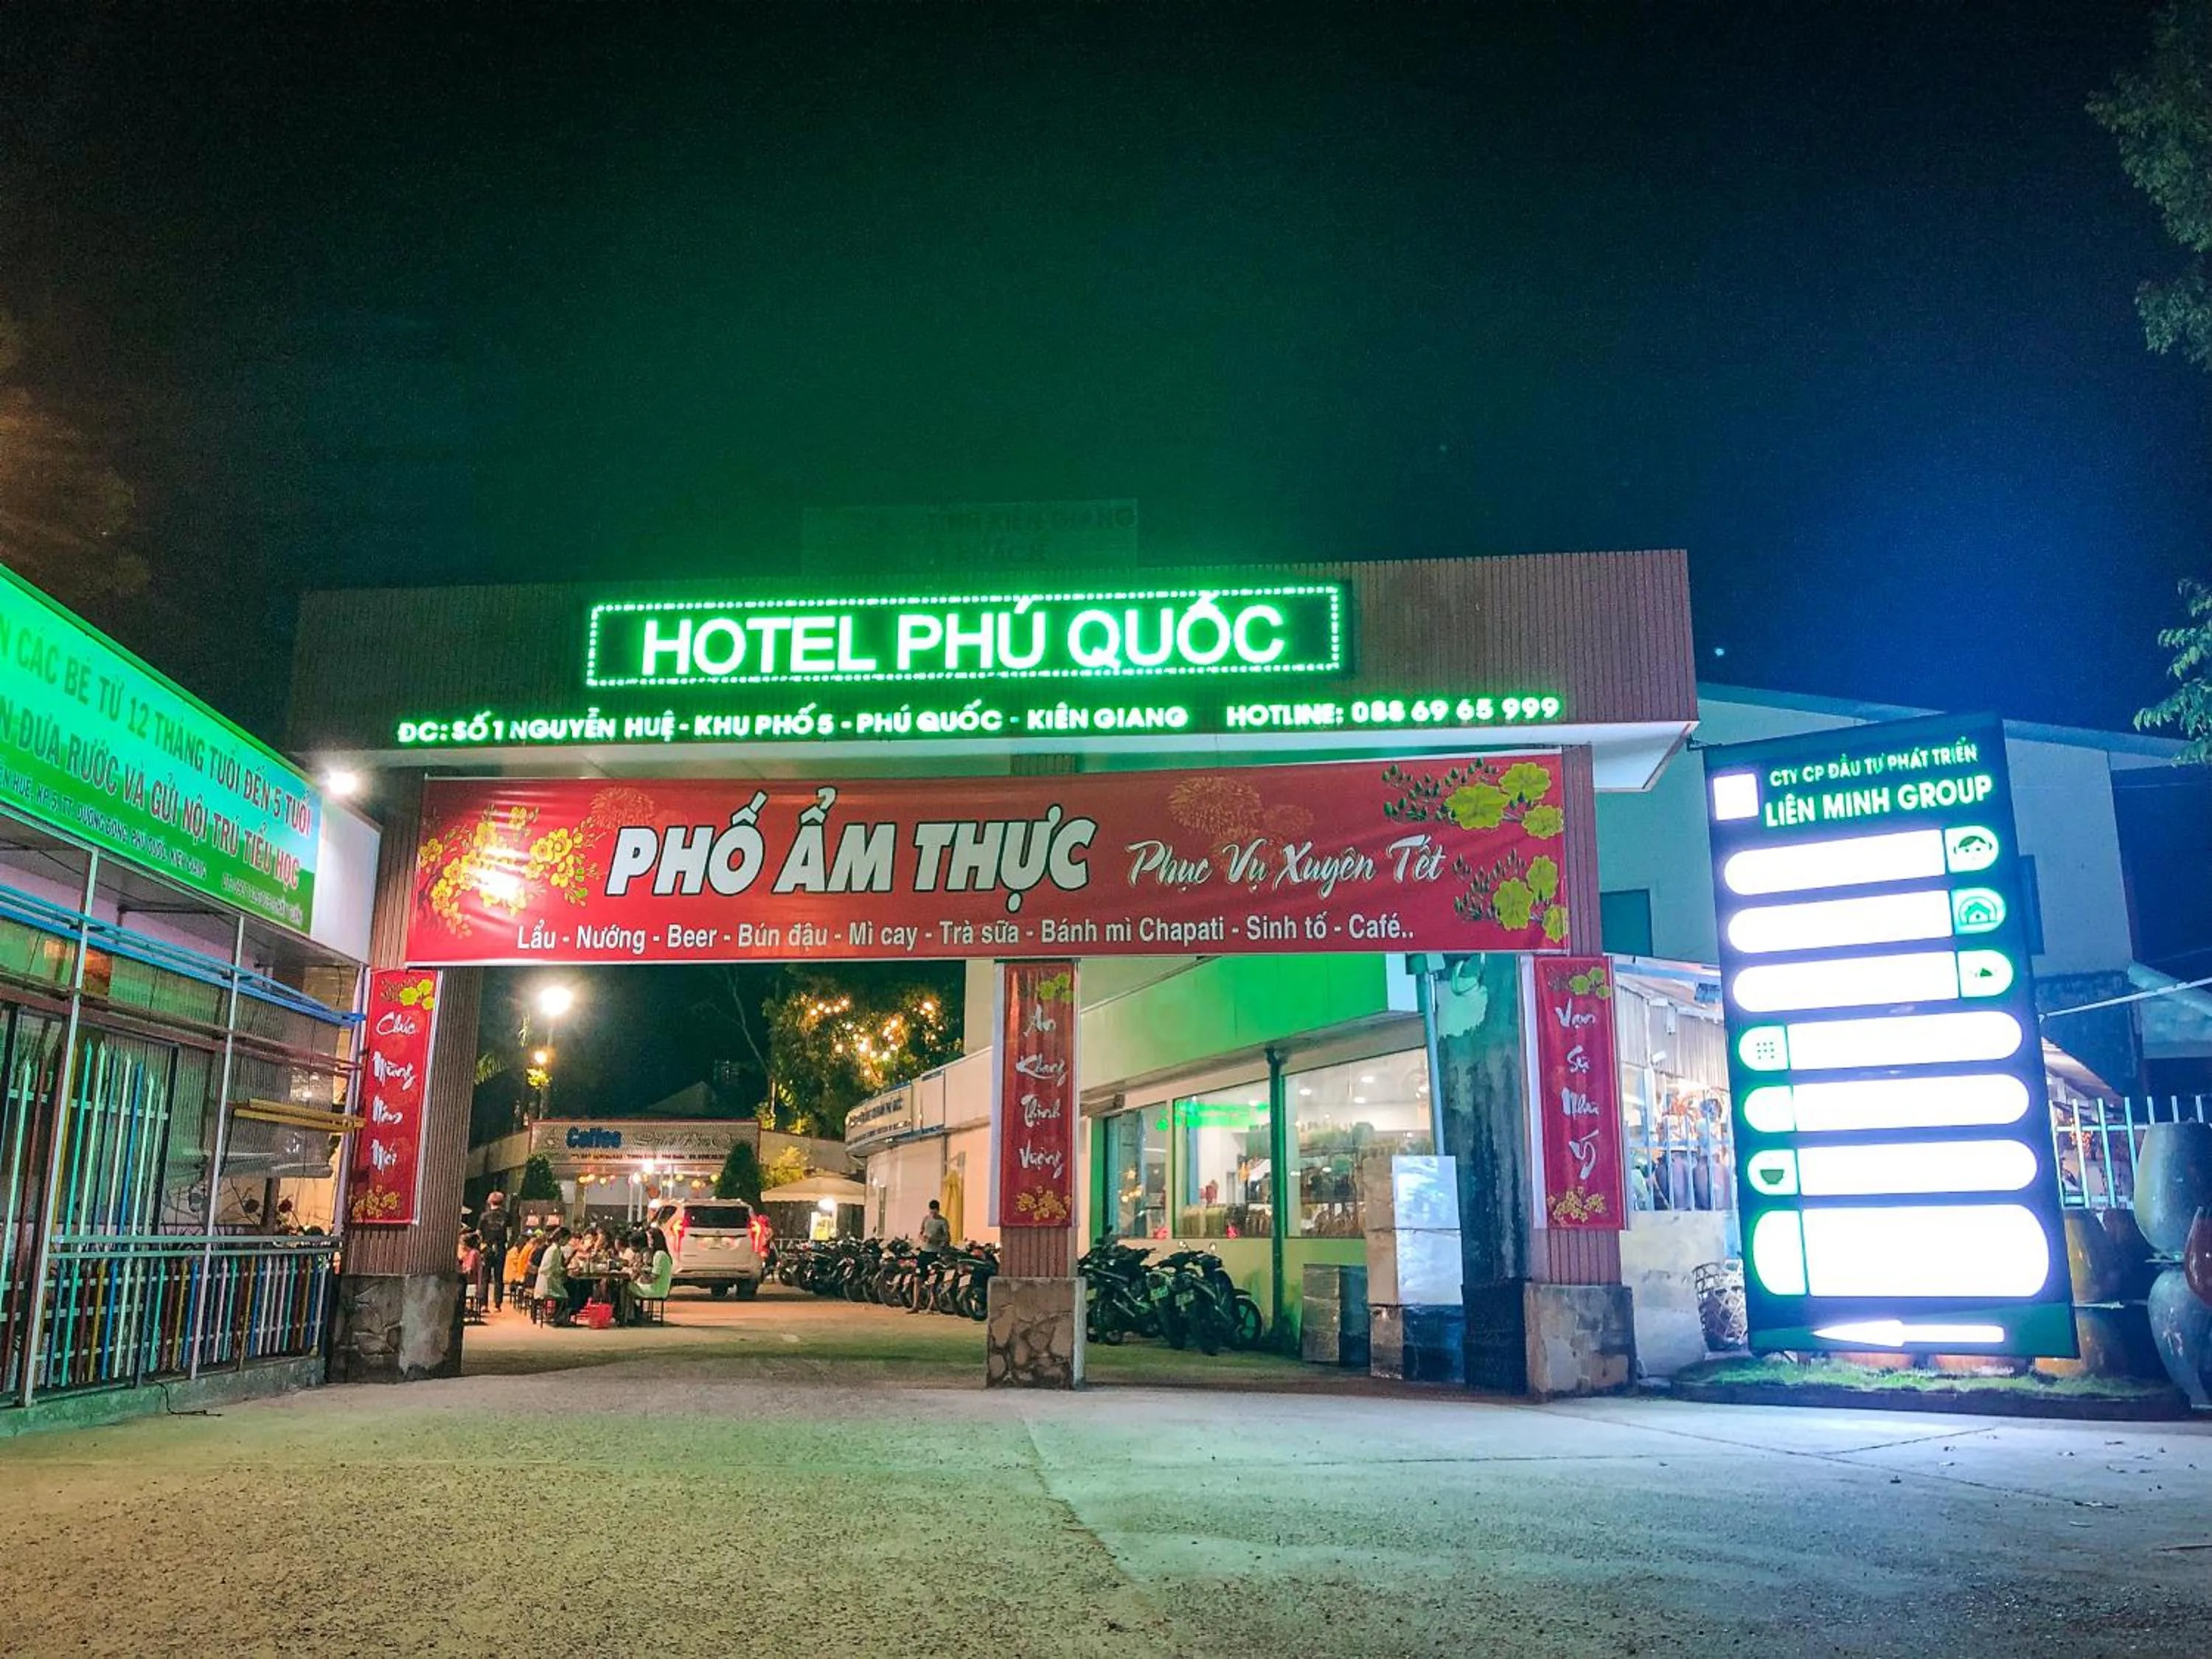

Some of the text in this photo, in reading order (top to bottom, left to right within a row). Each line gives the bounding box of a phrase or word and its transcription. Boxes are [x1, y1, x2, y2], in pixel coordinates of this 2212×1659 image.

[640, 593, 1286, 675] HOTEL PHÚ QUỐC
[17, 627, 59, 684] CÁC
[128, 697, 149, 740] 12
[243, 765, 271, 812] ĐẾN
[274, 787, 282, 817] 5
[509, 707, 616, 740] NGUYỄN
[624, 710, 675, 742] HUỆ
[694, 714, 750, 737] KHU
[754, 703, 816, 735] PHỐ
[856, 704, 912, 733] PHÚ
[916, 699, 1003, 732] QUỐC
[1027, 701, 1089, 730] KIÊN
[1093, 706, 1189, 729] GIANG
[1226, 697, 1559, 727] HOTLINE: 088 69 65 999
[1770, 736, 1978, 787] CTY CP ĐẦU TƯ PHÁT TRIỂN
[18, 707, 60, 767] ĐƯA
[66, 733, 119, 796] RƯỚC
[123, 761, 145, 810] VÀ
[150, 773, 179, 827] GỬI
[182, 793, 209, 846] NỘI
[212, 813, 240, 858] TRÚ
[243, 821, 272, 874] TIỂU
[274, 847, 299, 891] HỌC
[1764, 774, 1993, 827] LIÊN MINH GROUP
[605, 787, 1447, 914] PHỐ ẨM THỰC Phục Vụ Xuyên Tết
[517, 919, 556, 950] Lẩu
[576, 924, 646, 955] Nướng
[667, 924, 717, 948] Beer
[738, 922, 780, 947] Bún
[788, 922, 827, 951] đậu
[849, 921, 873, 945] Mì
[880, 927, 918, 950] cay
[939, 919, 974, 945] Trà
[981, 919, 1019, 945] sữa
[1041, 918, 1097, 943] Bánh
[1106, 917, 1131, 942] mì
[1139, 916, 1224, 947] Chapati
[1246, 915, 1297, 940] Sinh
[1304, 911, 1328, 939] tố
[376, 1012, 417, 1035] Chúc
[1023, 1004, 1057, 1037] An
[1555, 998, 1596, 1029] Vạn
[1015, 1054, 1066, 1086] Khang
[1567, 1045, 1590, 1074] Sự
[1020, 1093, 1060, 1127] Thịnh
[1019, 1141, 1062, 1179] Vượng
[1568, 1129, 1599, 1180] Ý
